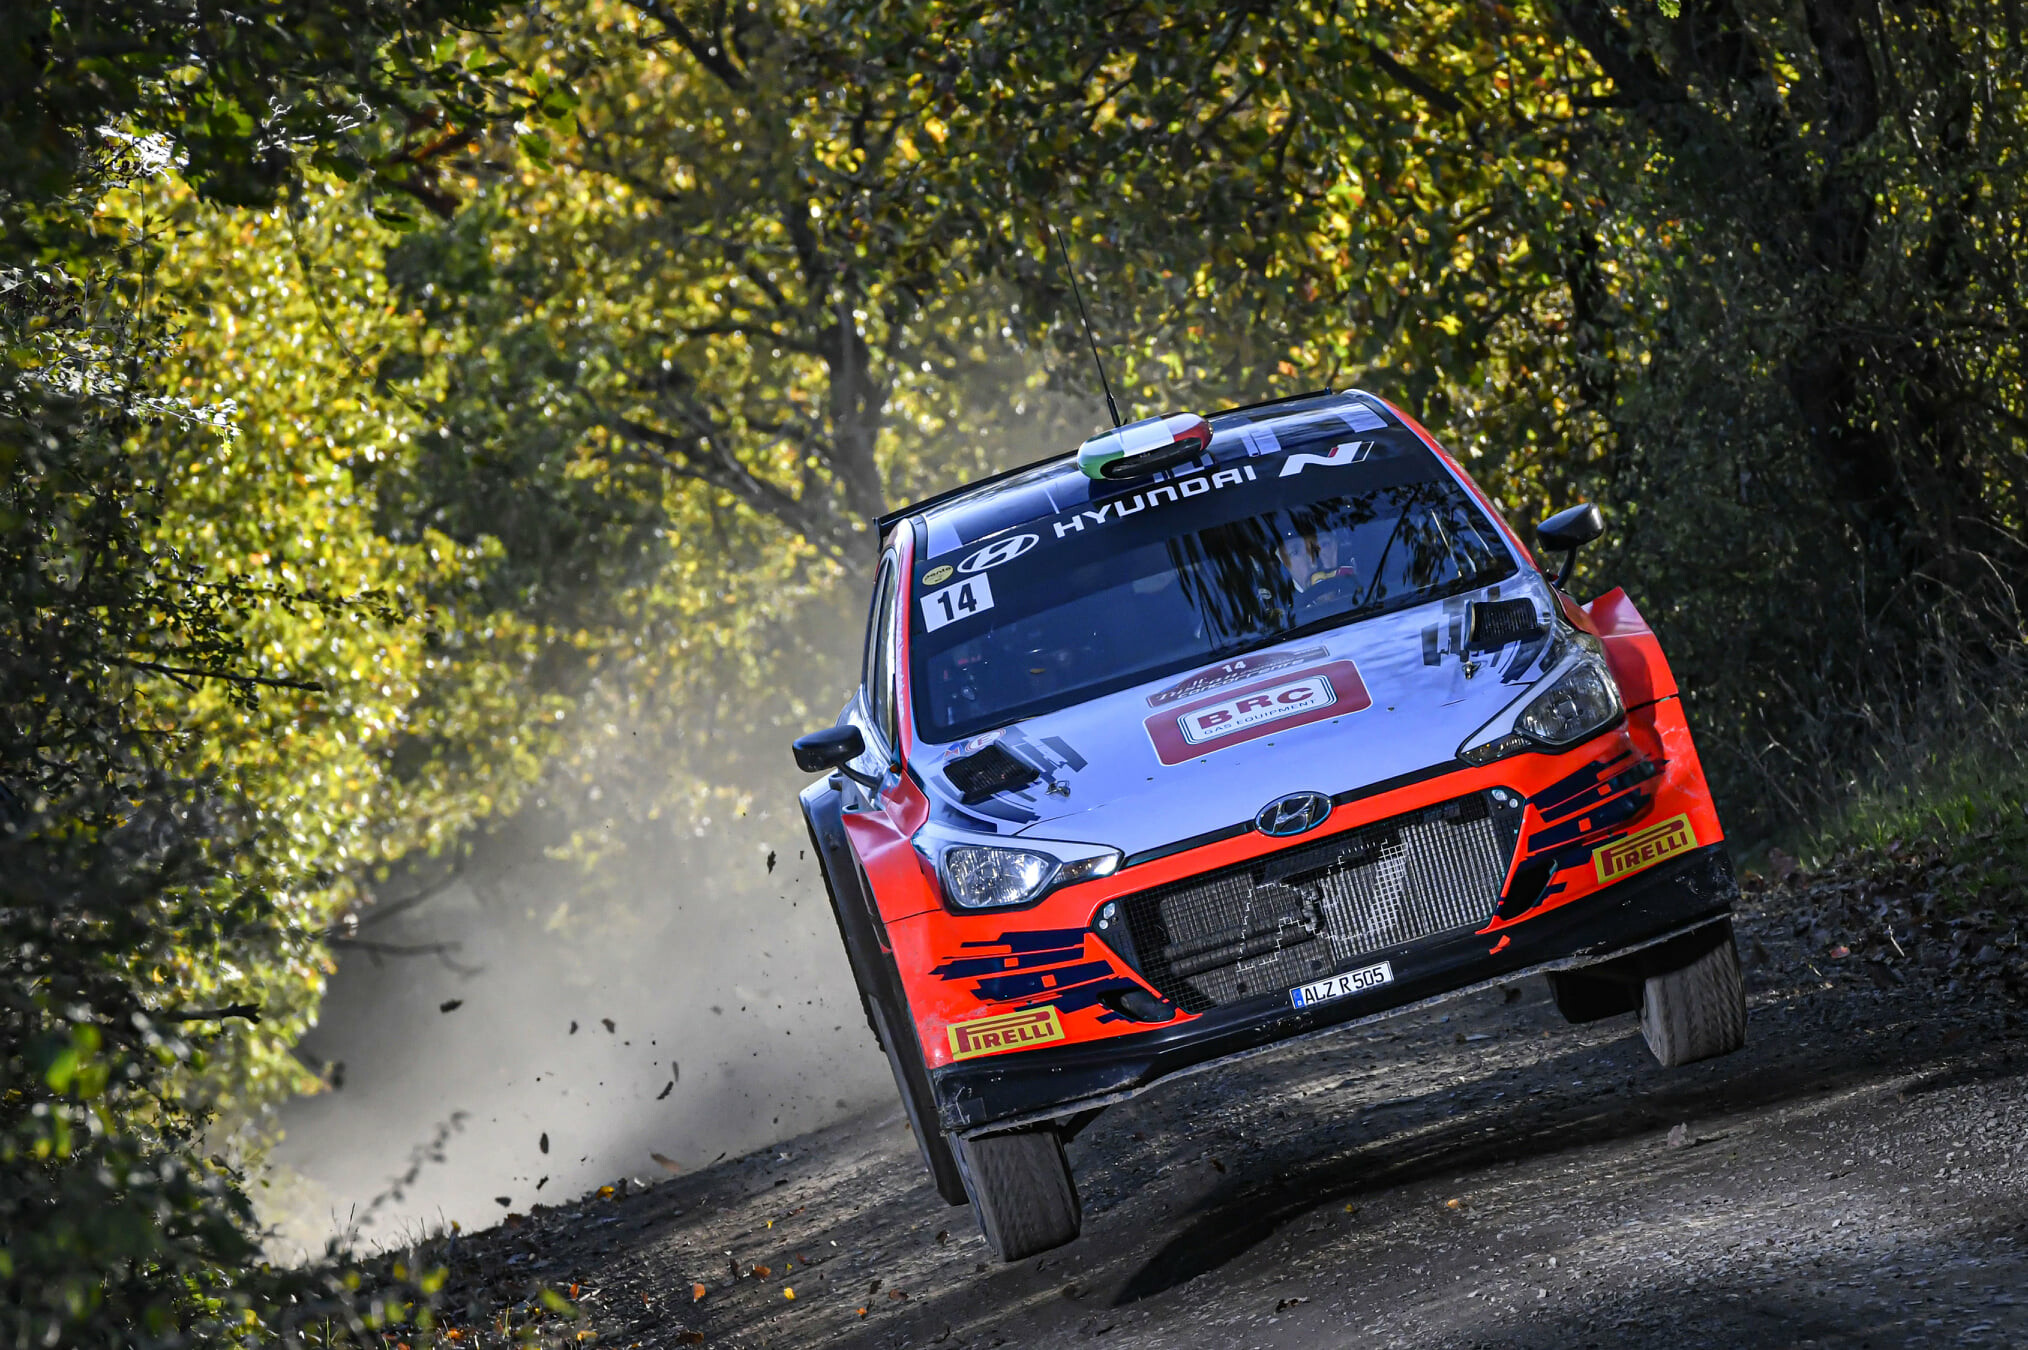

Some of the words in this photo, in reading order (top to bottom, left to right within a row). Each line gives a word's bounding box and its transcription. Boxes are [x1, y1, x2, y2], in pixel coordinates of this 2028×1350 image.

[1053, 465, 1257, 538] HYUNDAI
[937, 582, 977, 621] 14
[1222, 660, 1247, 673] 14
[1197, 687, 1314, 729] BRC
[1204, 722, 1232, 735] GAS
[1236, 699, 1316, 725] EQUIPMENT
[1600, 819, 1688, 877] PIRELLI
[1304, 981, 1336, 1005] ALZ
[1352, 967, 1385, 990] 505
[955, 1011, 1055, 1054] PIRELLI
